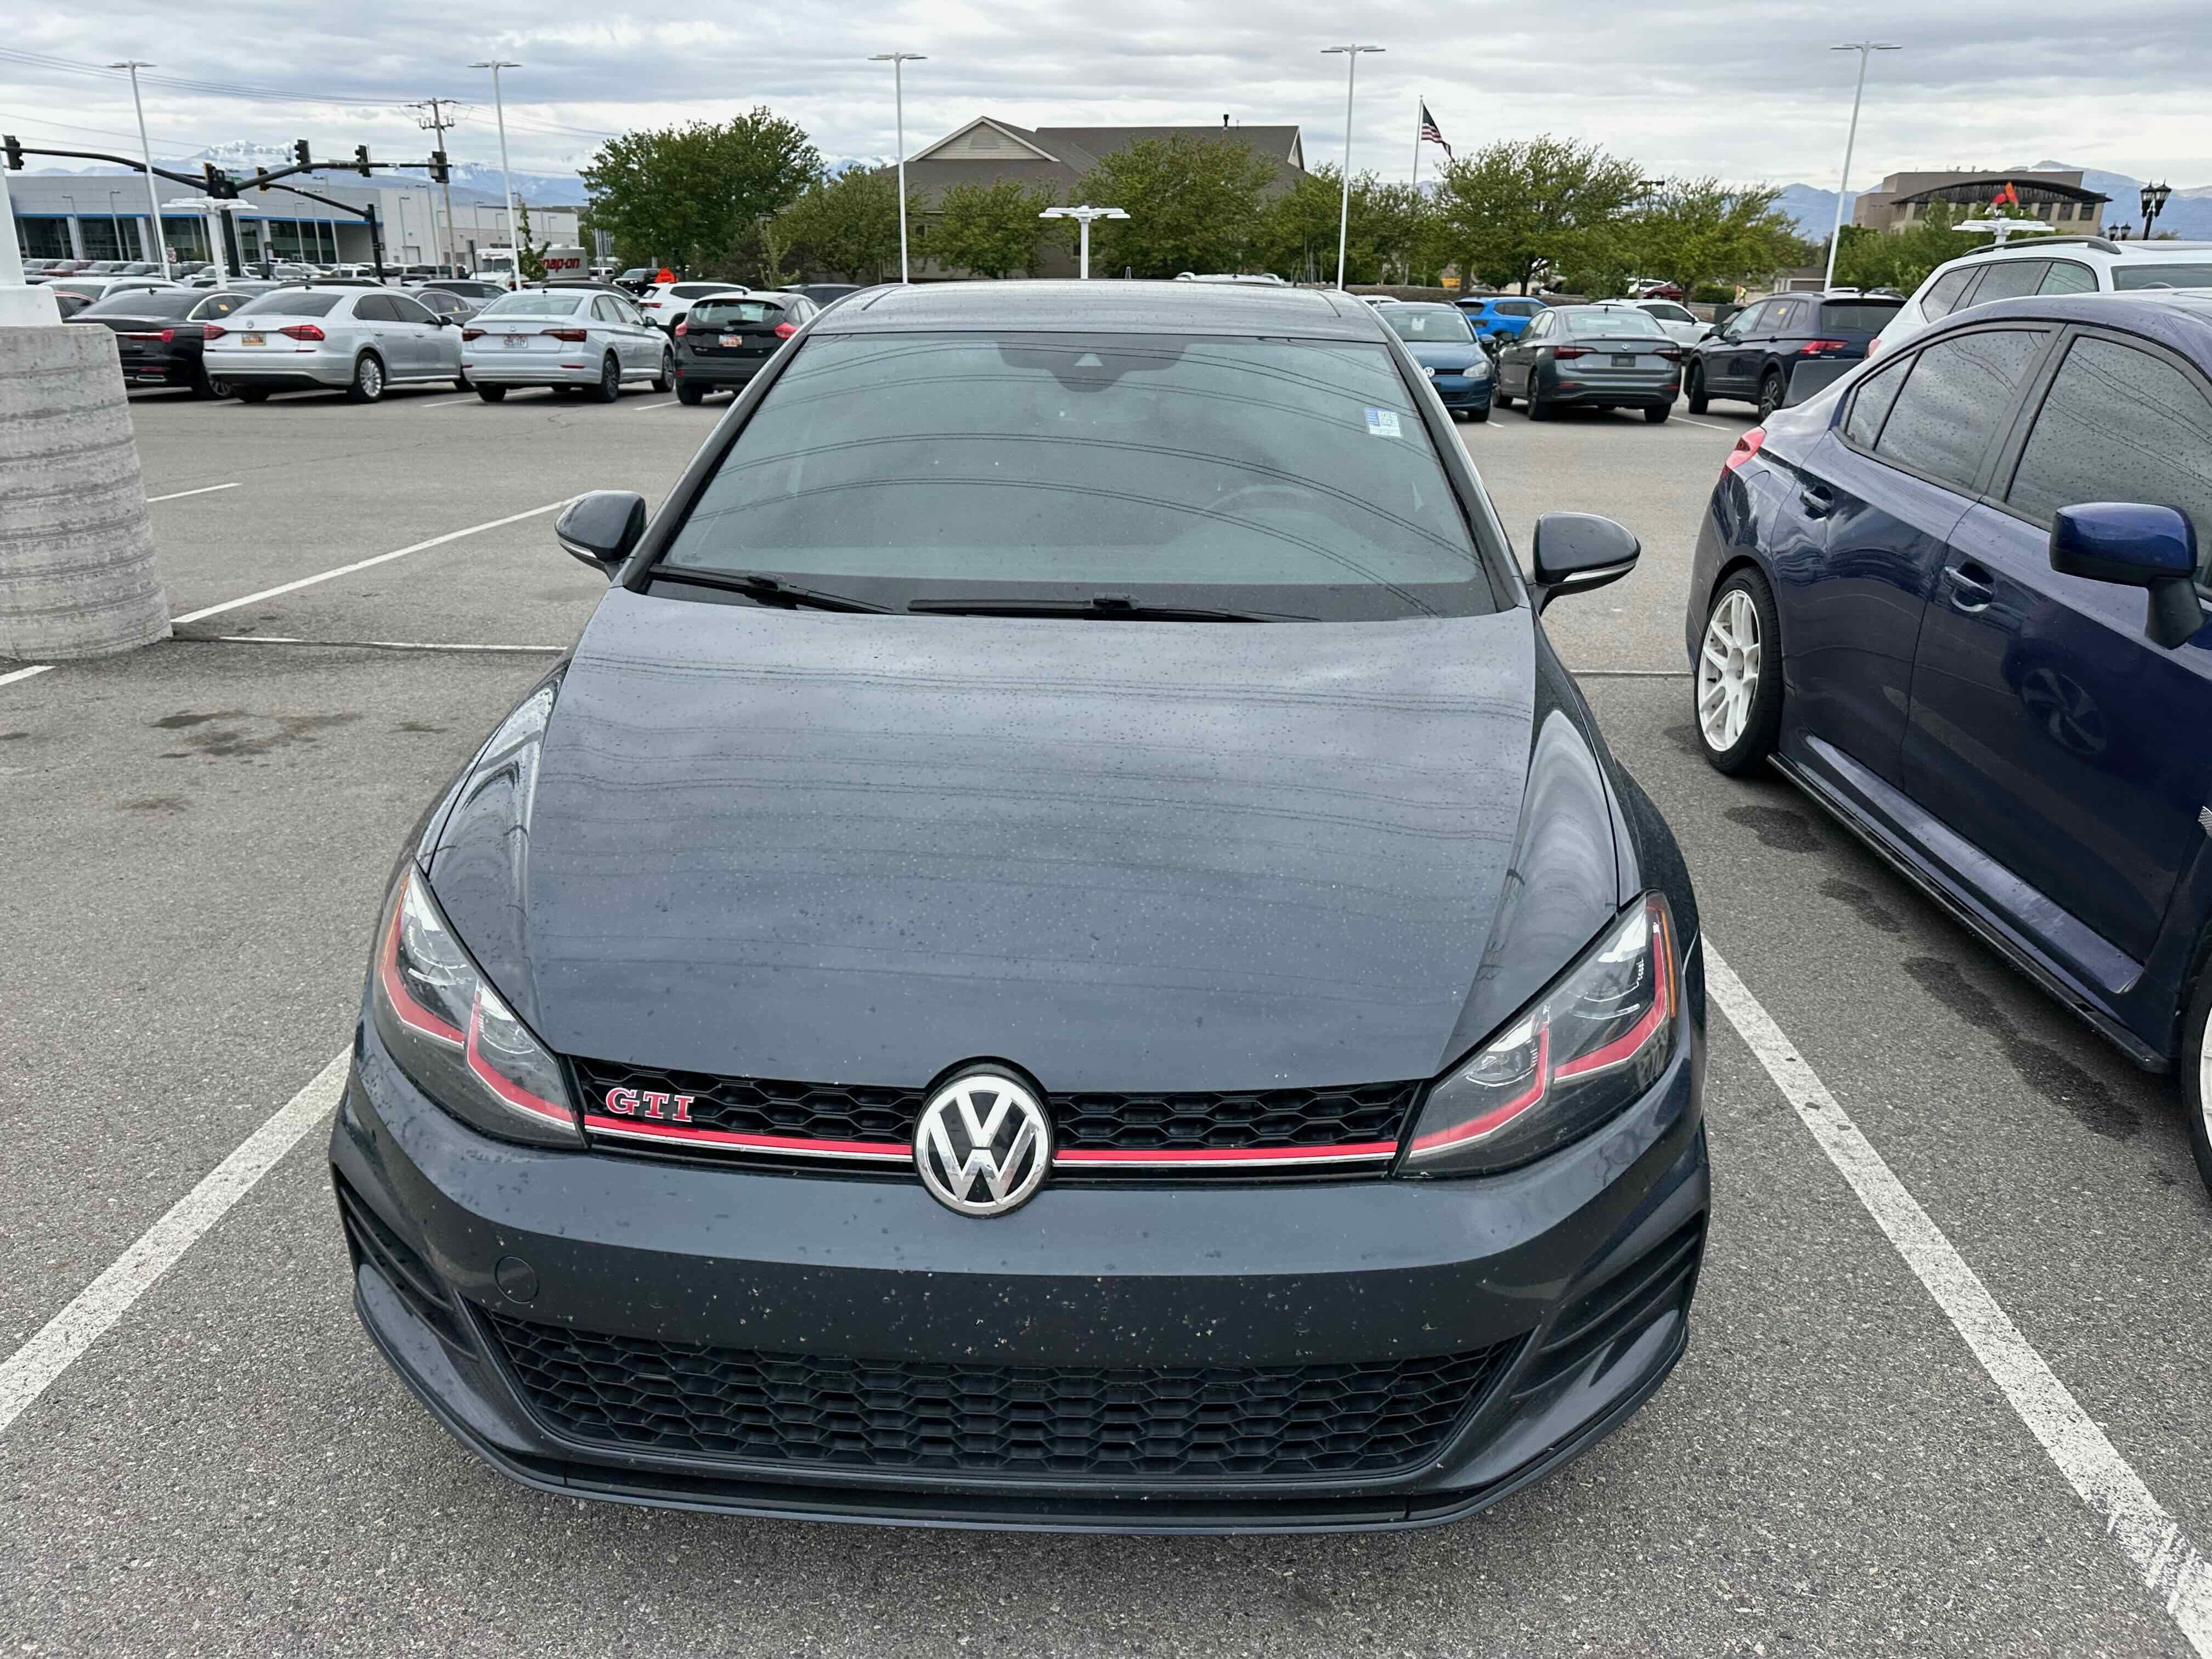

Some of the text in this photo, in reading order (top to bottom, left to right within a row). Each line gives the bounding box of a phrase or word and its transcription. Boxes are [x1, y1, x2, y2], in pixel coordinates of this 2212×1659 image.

[540, 257, 580, 273] nap-on
[606, 1087, 695, 1123] GTI
[921, 1082, 1043, 1210] VW
